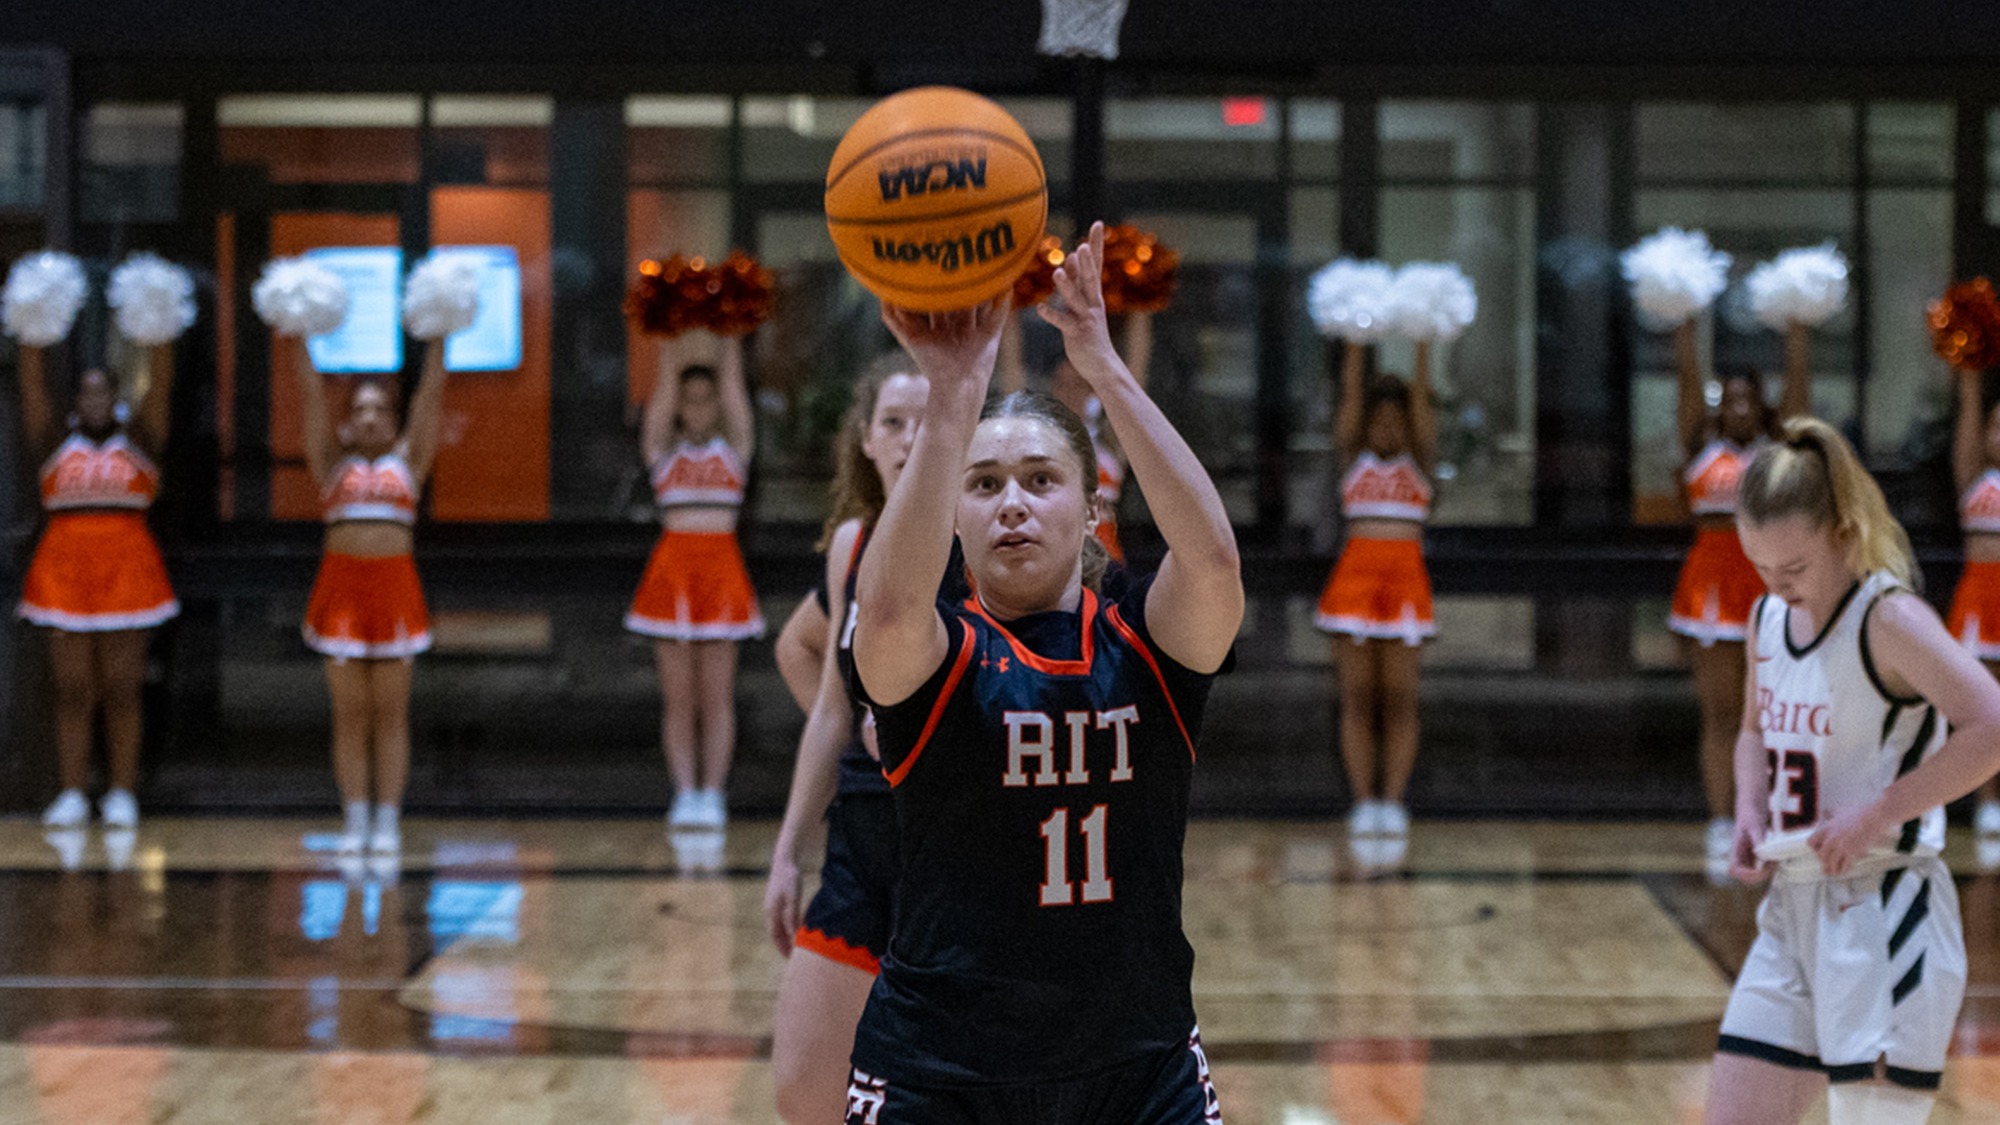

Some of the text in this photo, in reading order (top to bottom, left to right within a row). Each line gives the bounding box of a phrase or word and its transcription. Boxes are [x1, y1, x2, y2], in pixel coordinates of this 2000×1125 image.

[878, 158, 987, 203] NCAA
[871, 219, 1014, 271] Wilson
[1003, 704, 1140, 787] RIT
[1767, 747, 1820, 834] 3
[1039, 804, 1114, 907] 11
